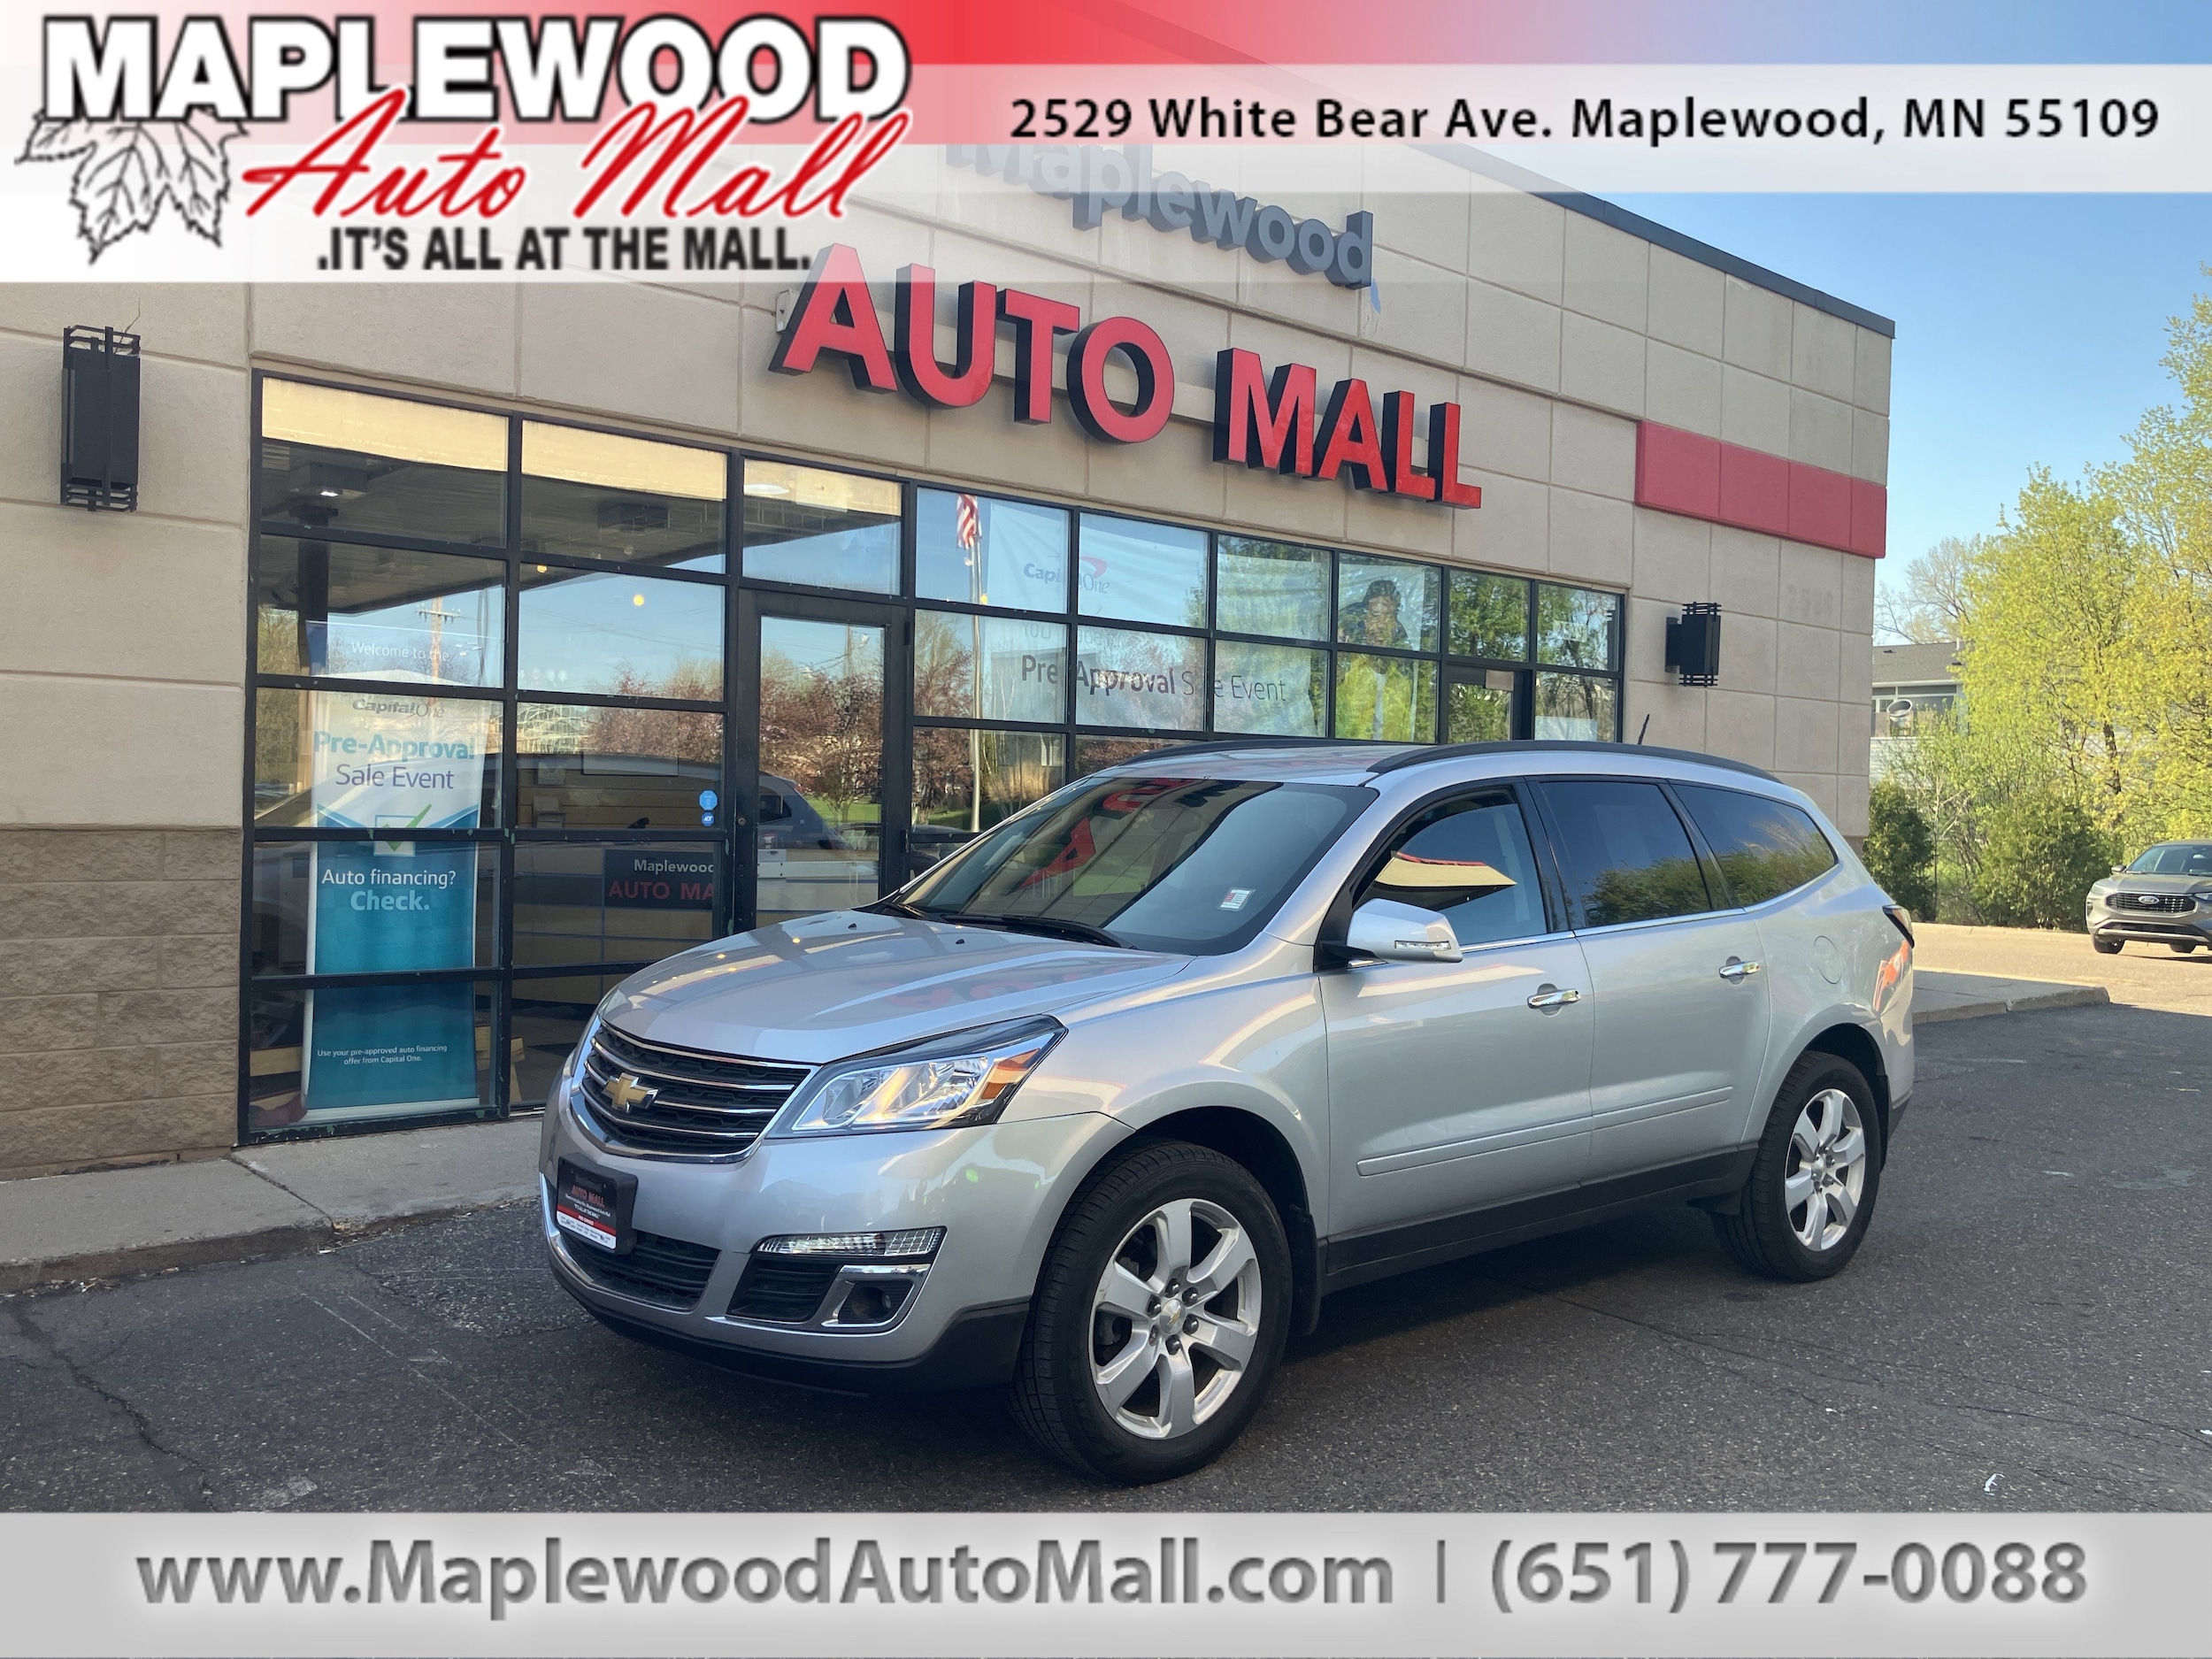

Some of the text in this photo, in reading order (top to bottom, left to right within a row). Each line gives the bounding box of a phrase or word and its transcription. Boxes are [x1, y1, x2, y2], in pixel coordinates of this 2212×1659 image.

[768, 242, 1481, 509] AUTO MALL
[350, 641, 449, 662] Welcome to the
[1231, 675, 1286, 702] Event
[313, 731, 475, 762] Pre-Approval
[335, 764, 455, 789] Sale Event
[321, 868, 457, 889] Auto financing?
[350, 889, 430, 911] Check.
[608, 880, 671, 900] AUTO
[350, 1046, 397, 1056] pre-approved
[416, 1044, 448, 1053] financing
[362, 1056, 380, 1064] from
[380, 1054, 405, 1064] Capital
[571, 1185, 588, 1201] AUTO
